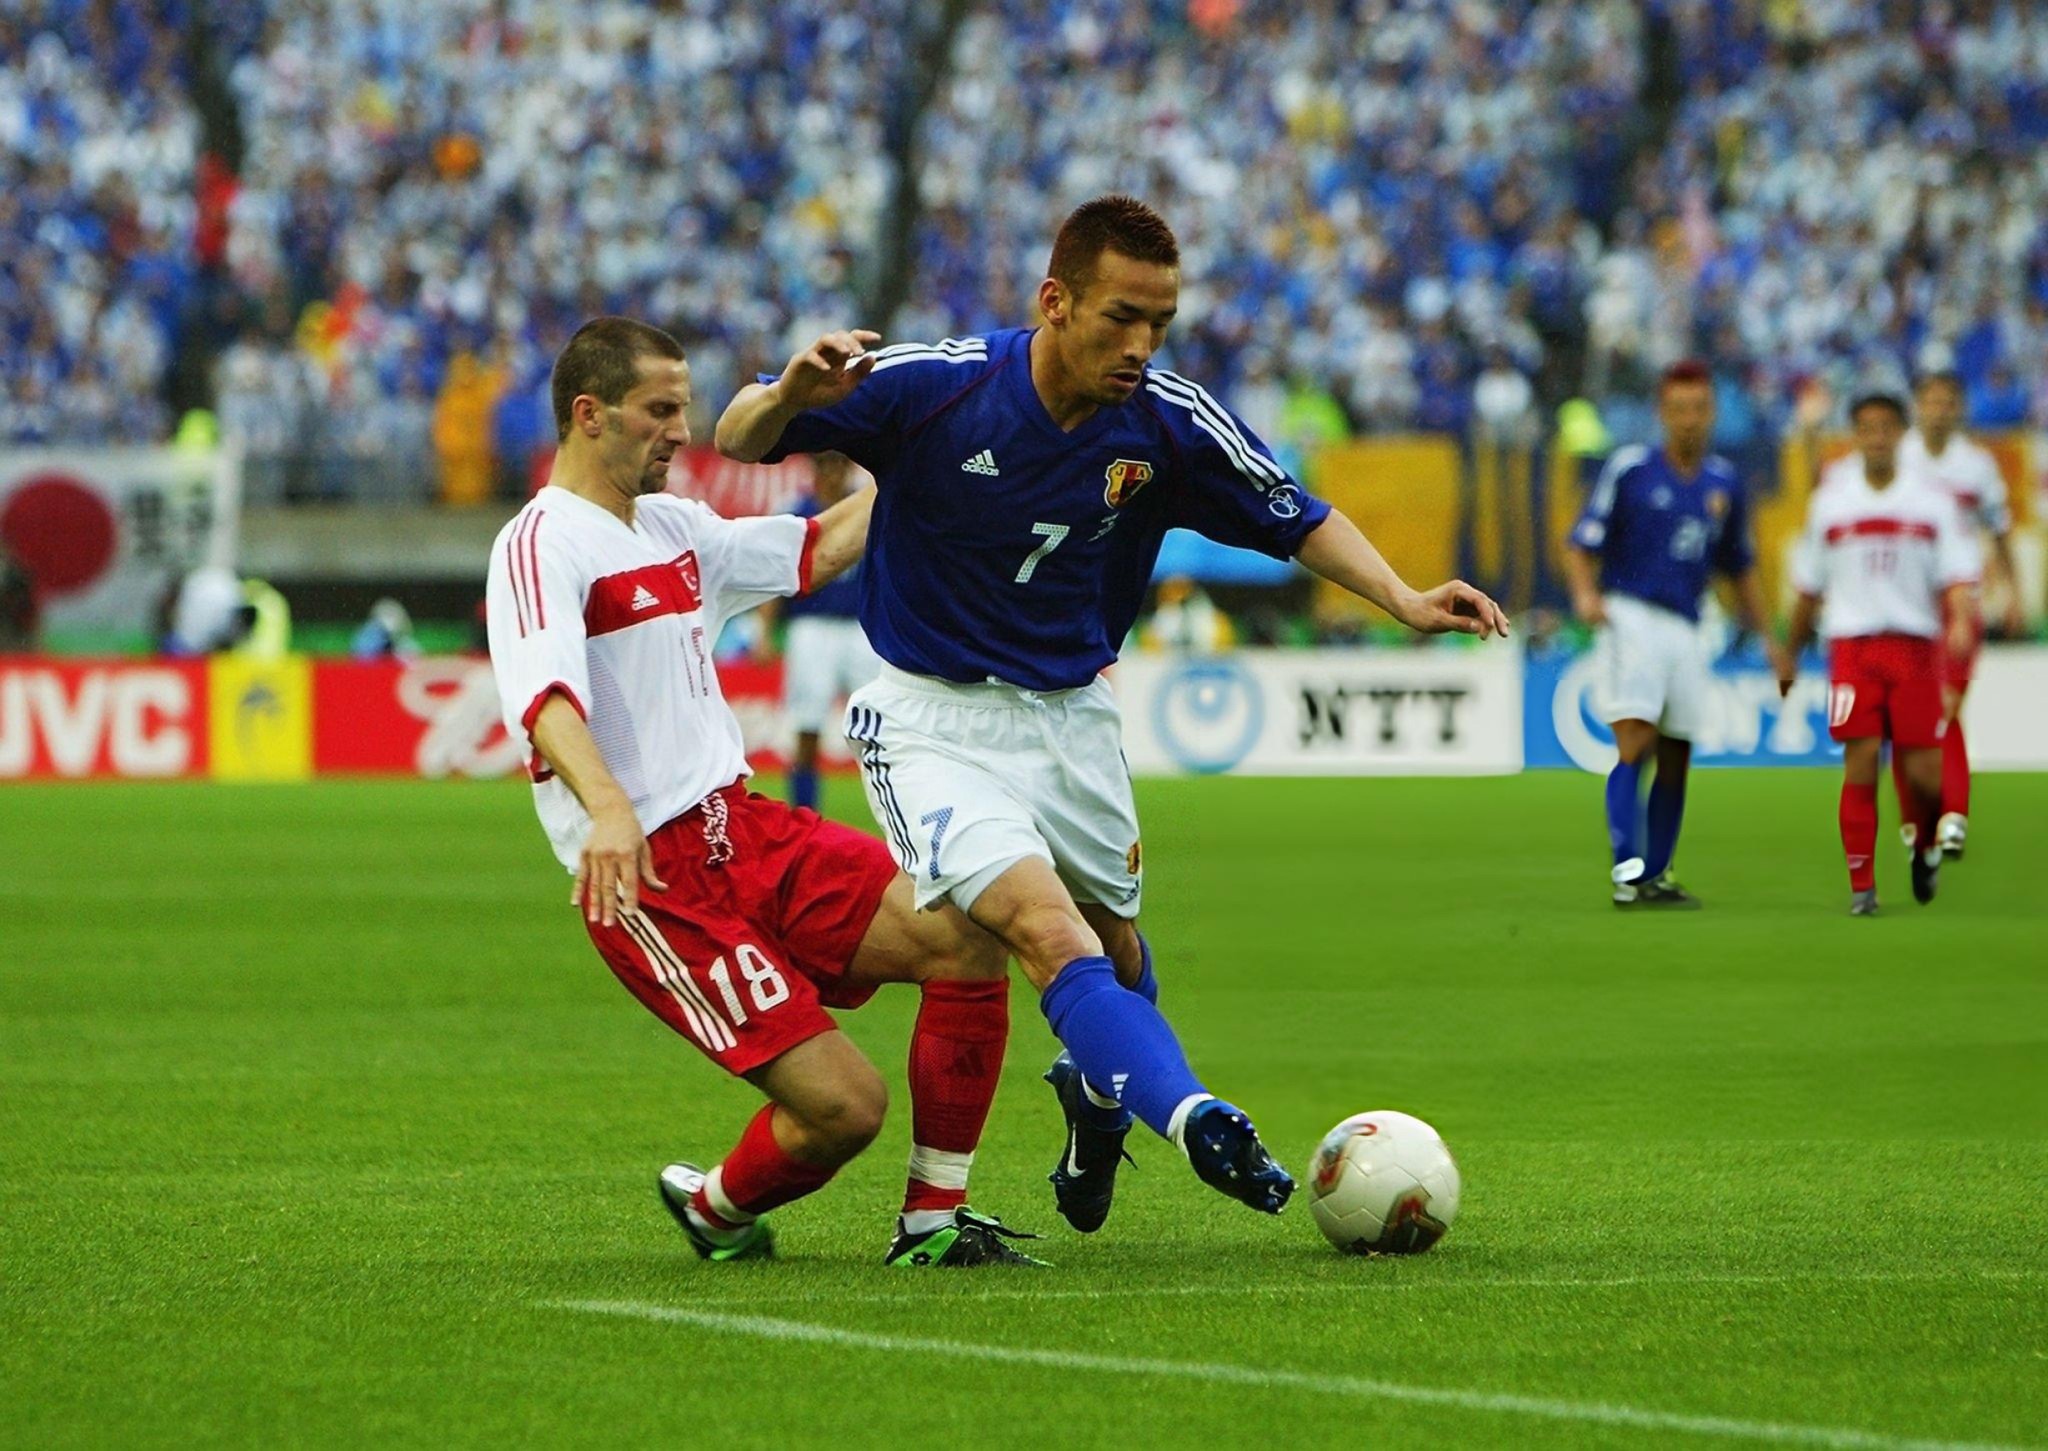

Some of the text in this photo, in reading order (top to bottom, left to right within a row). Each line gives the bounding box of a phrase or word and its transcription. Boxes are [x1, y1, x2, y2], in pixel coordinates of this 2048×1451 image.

[961, 463, 1000, 477] adidas
[1014, 522, 1071, 584] 7
[1298, 683, 1471, 746] NTT
[920, 806, 954, 881] 7
[708, 943, 790, 1027] 18
